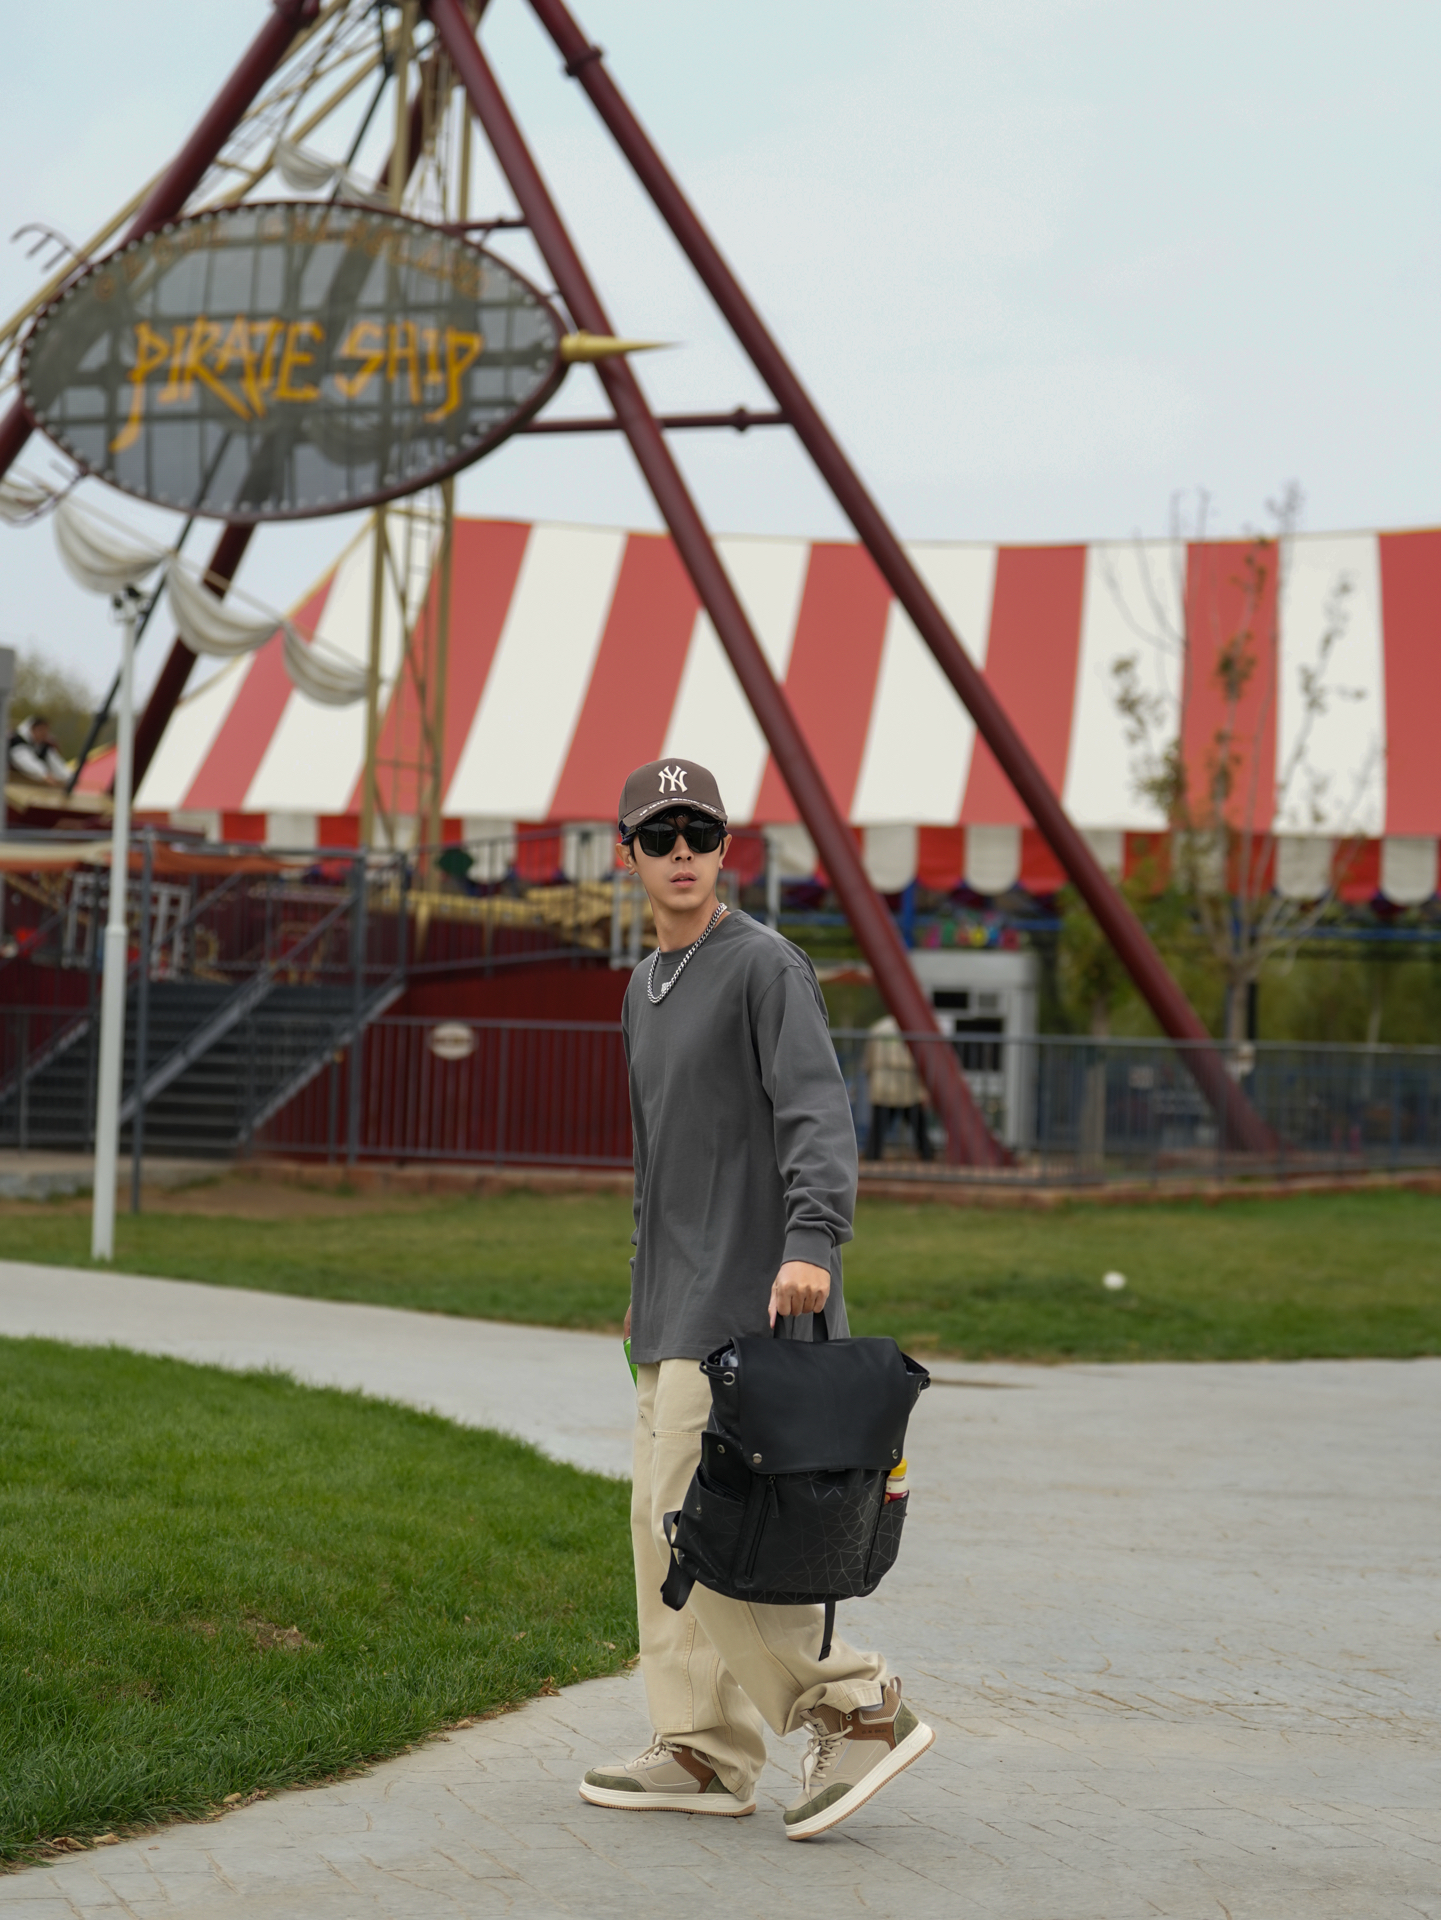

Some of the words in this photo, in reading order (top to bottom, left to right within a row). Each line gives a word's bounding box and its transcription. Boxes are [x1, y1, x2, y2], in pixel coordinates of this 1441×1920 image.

[109, 313, 325, 454] PIRATE
[335, 320, 483, 424] SHIP
[658, 765, 688, 794] NY
